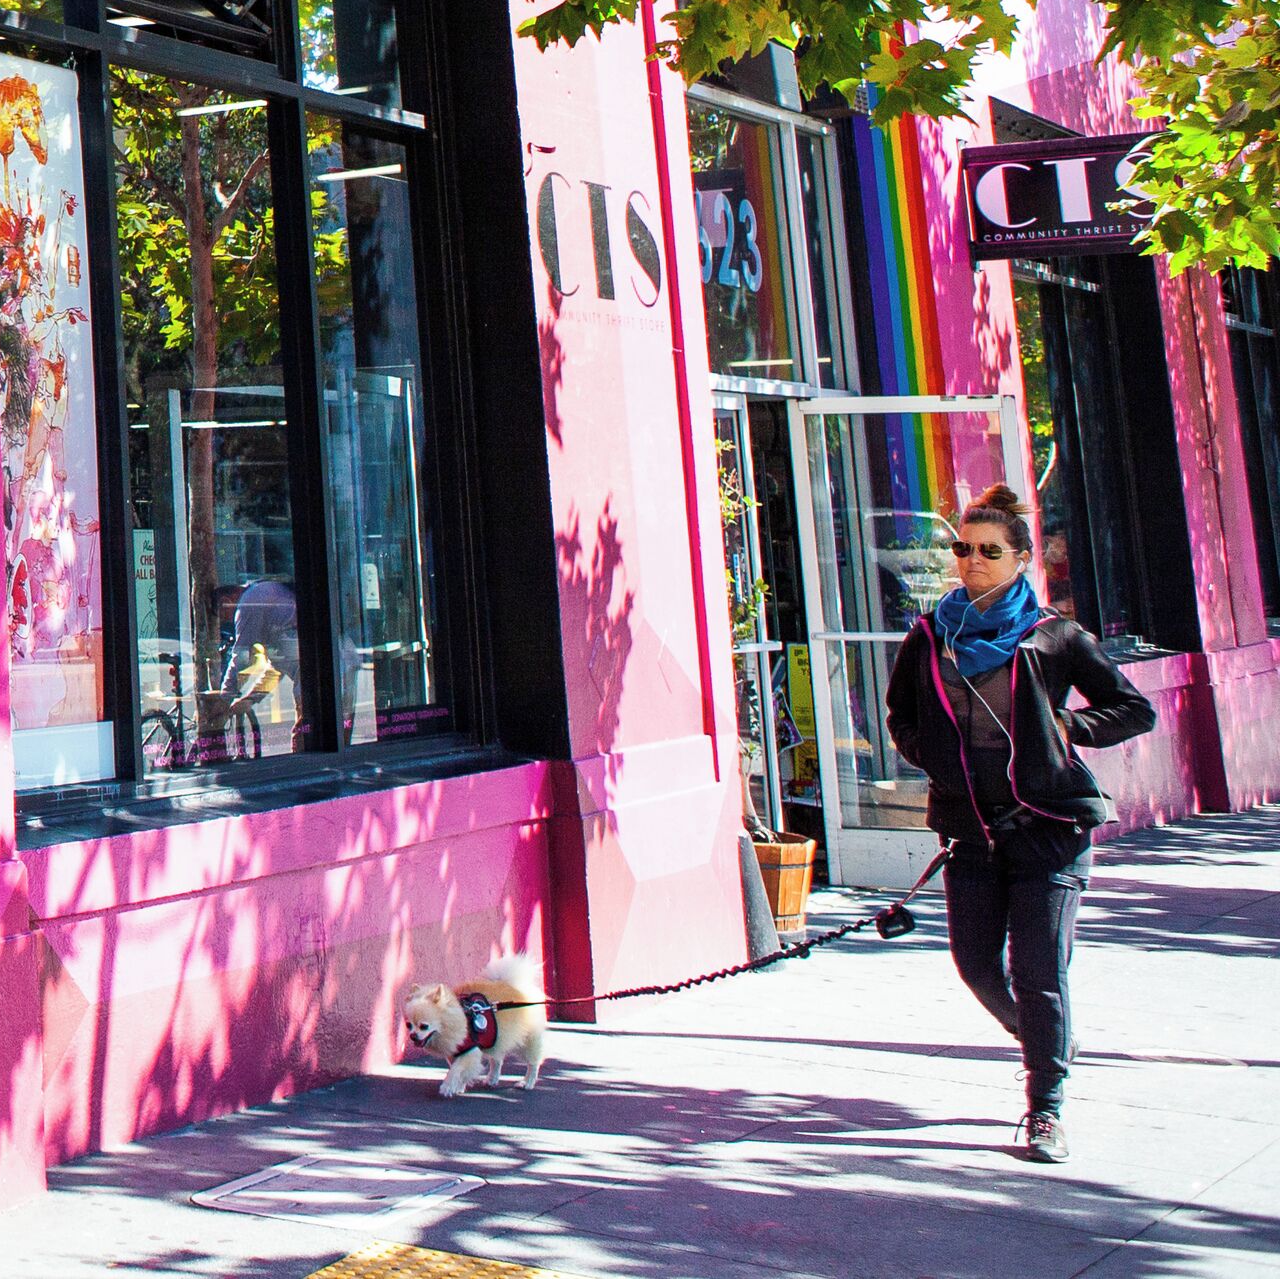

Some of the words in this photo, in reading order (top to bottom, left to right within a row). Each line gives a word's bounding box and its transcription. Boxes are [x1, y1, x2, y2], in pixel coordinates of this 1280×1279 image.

[537, 171, 661, 308] CTS
[983, 228, 1068, 243] COMMUNITY
[1075, 223, 1123, 236] THRIFT
